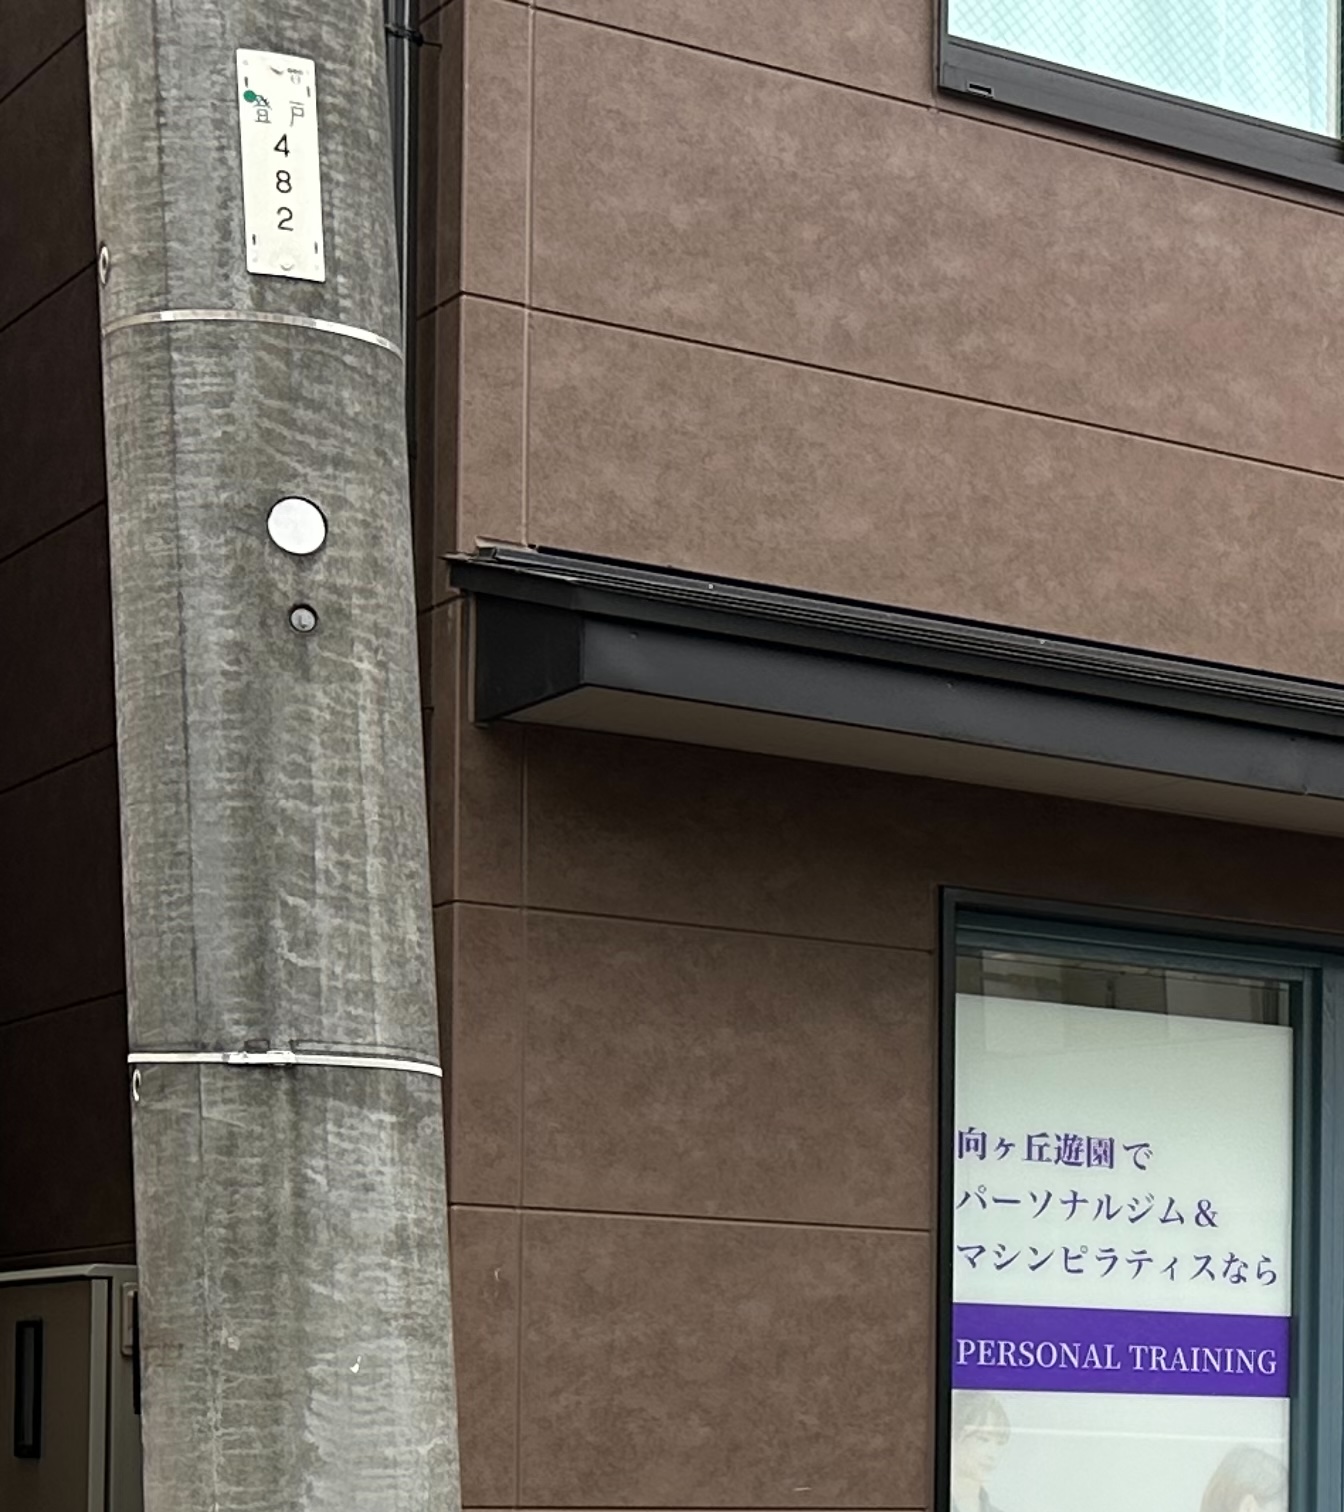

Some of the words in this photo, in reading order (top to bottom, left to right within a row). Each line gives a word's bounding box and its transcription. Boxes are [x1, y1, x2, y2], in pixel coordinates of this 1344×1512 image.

[273, 133, 294, 232] 482
[956, 1243, 1278, 1286] マシンピラティスなら
[956, 1338, 1122, 1372] PERSONAL
[1128, 1344, 1278, 1376] TRAINING
